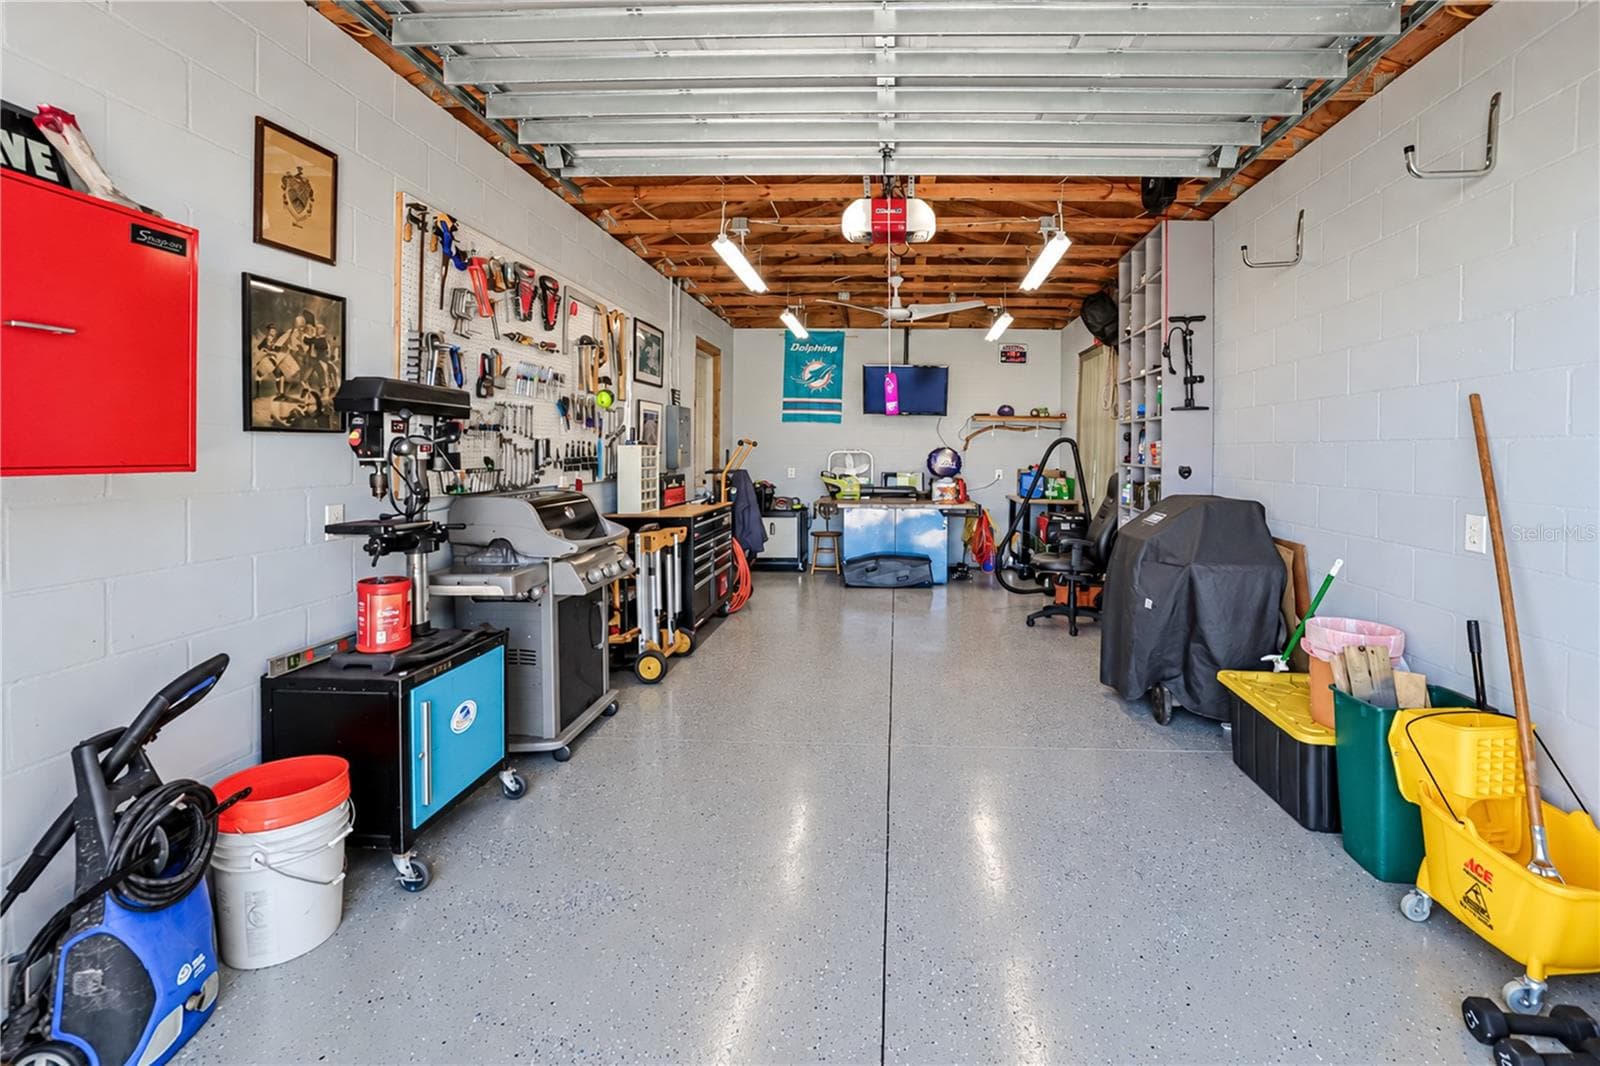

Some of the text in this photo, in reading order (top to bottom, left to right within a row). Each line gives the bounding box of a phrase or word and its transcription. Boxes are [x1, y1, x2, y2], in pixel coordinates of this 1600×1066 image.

[0, 129, 60, 182] VE
[136, 230, 183, 251] Snap-on
[790, 343, 838, 354] Dolphins
[1463, 858, 1494, 886] ACE
